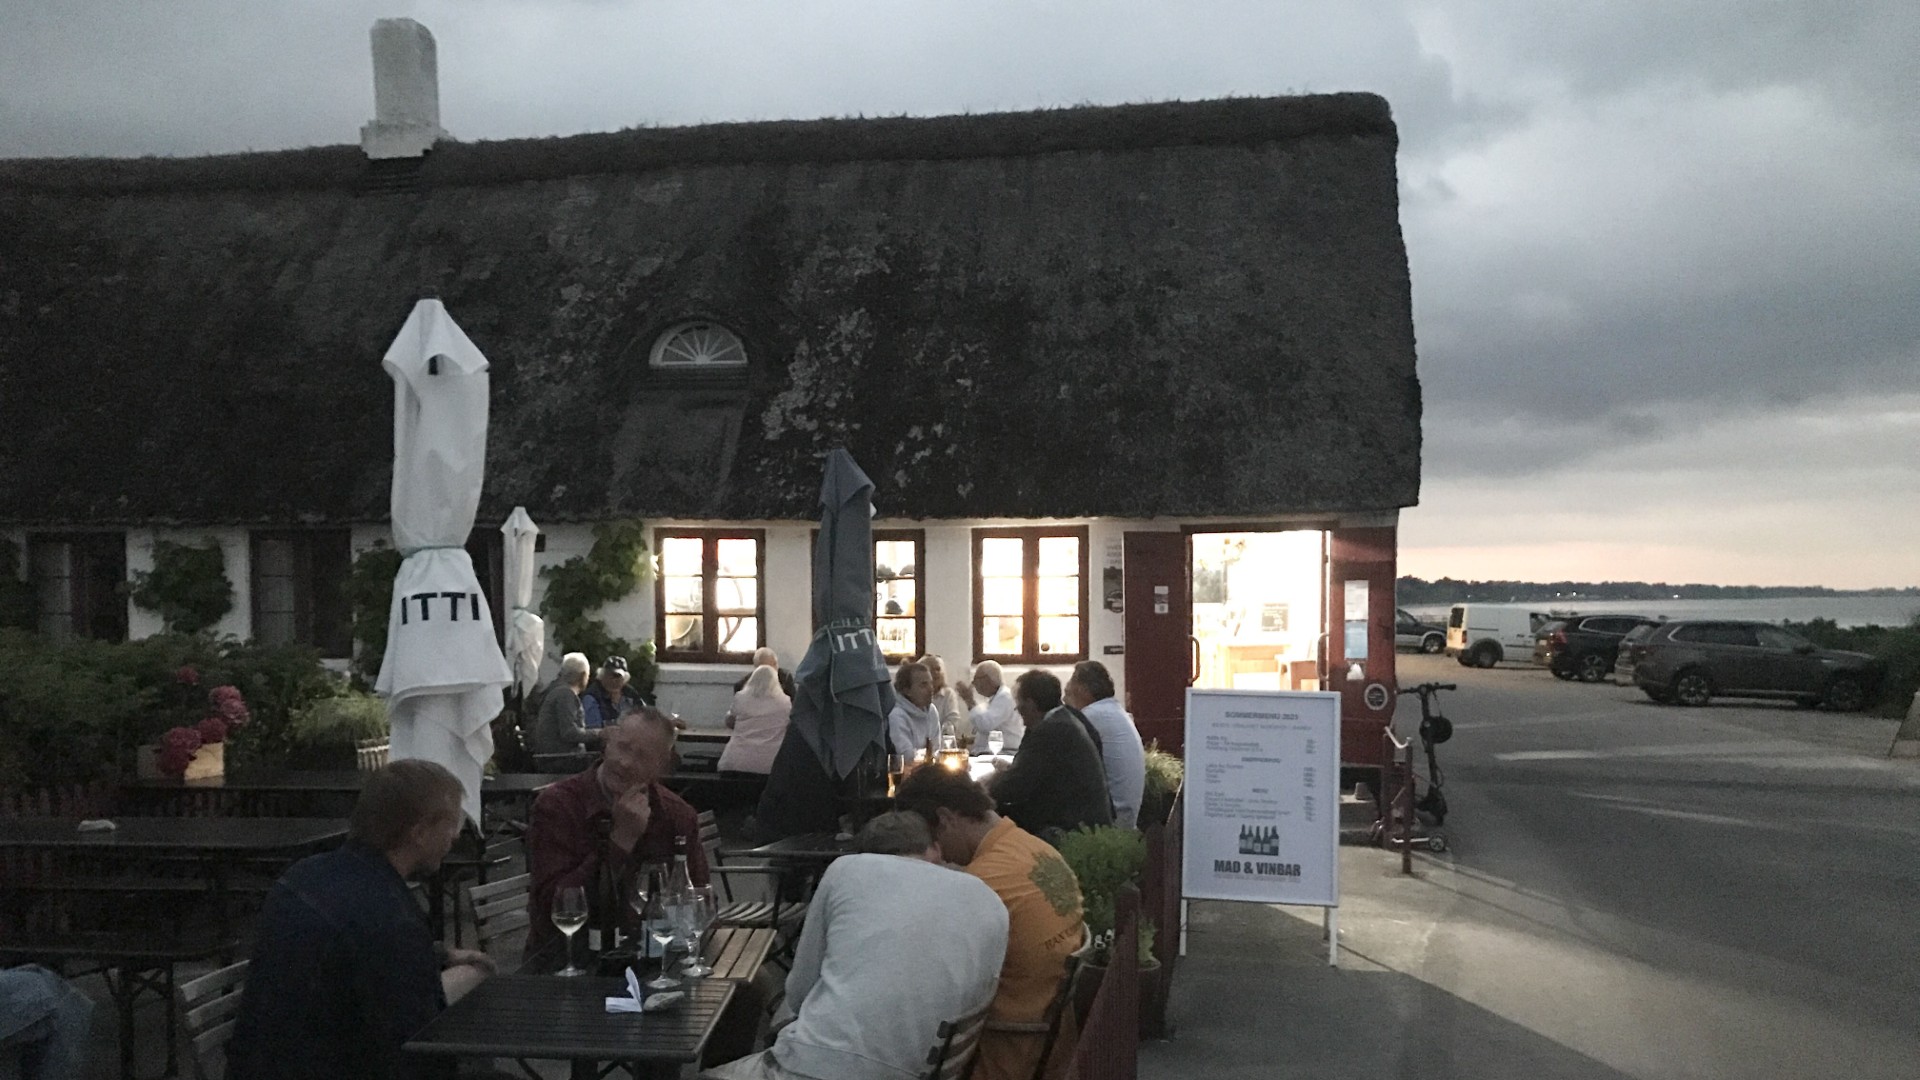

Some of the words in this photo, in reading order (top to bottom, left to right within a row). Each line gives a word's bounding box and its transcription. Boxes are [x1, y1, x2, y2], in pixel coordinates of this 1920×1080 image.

[1214, 860, 1241, 873] MAD
[1244, 862, 1253, 874] &
[1256, 862, 1302, 877] VINBAR
